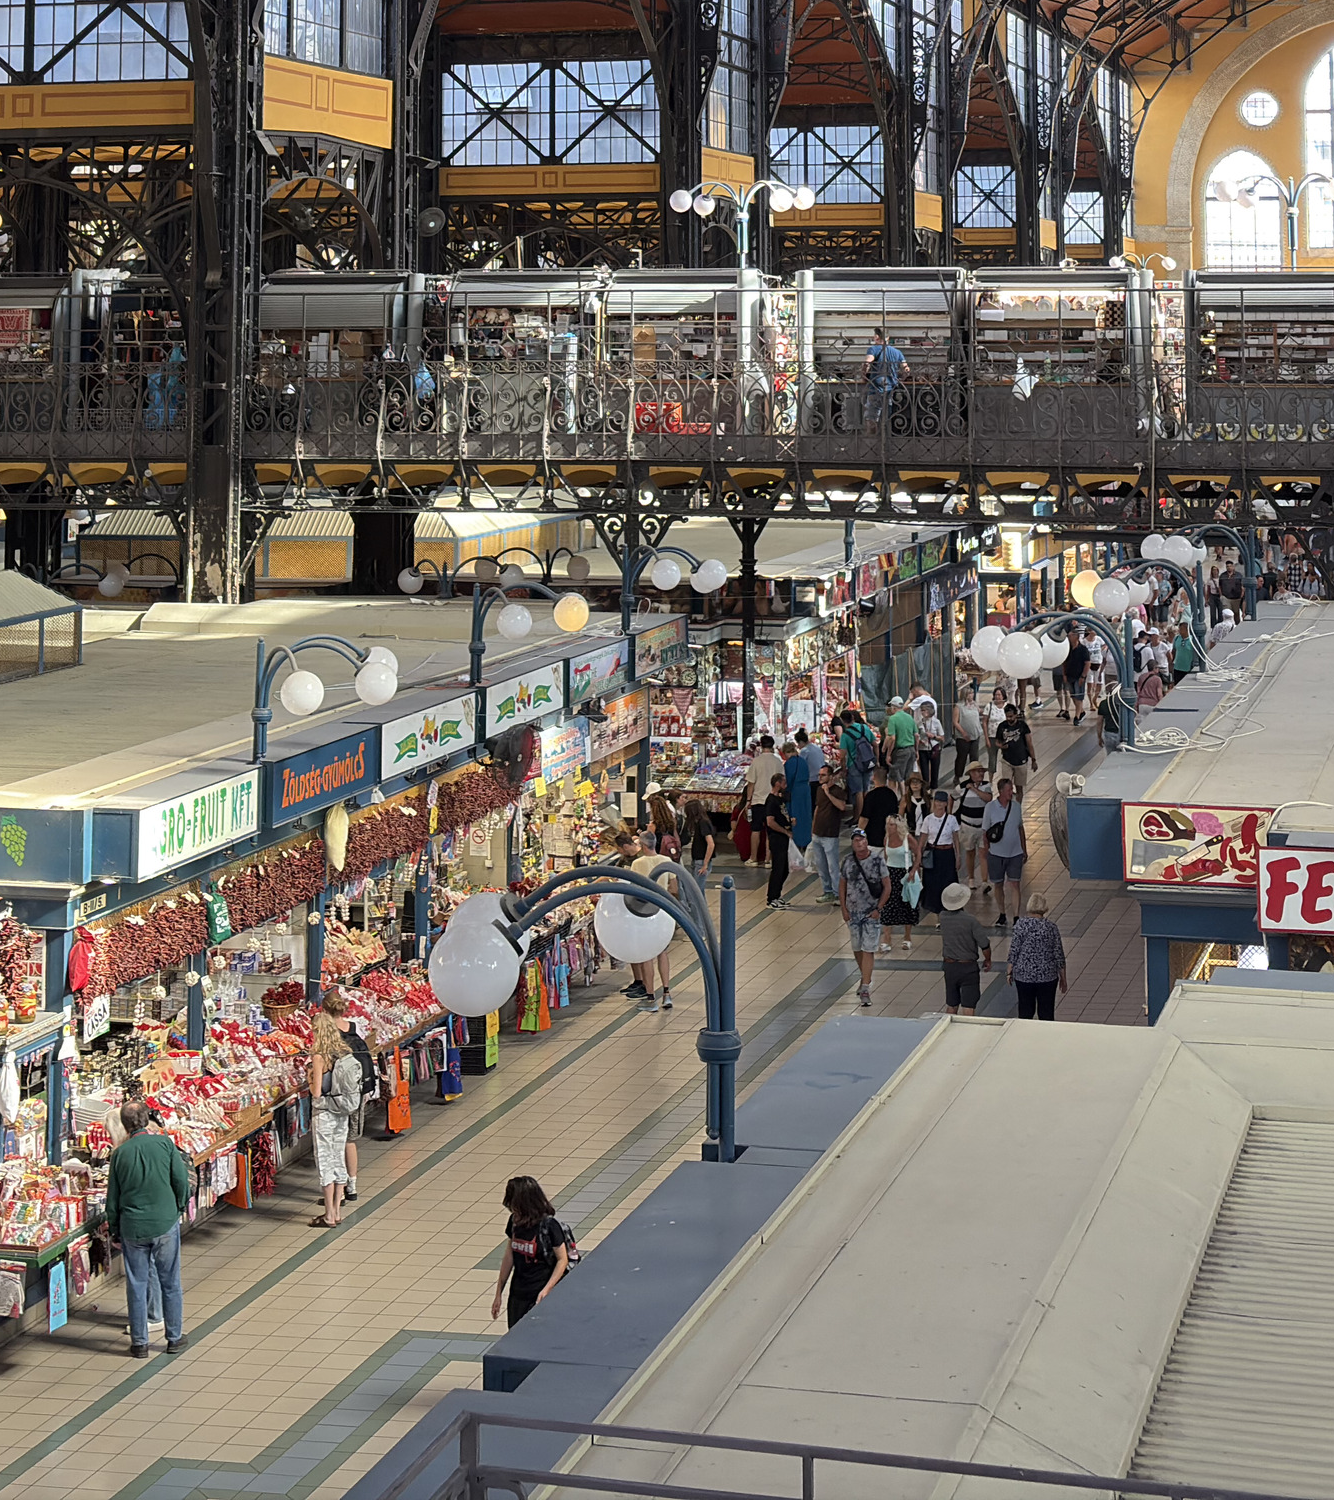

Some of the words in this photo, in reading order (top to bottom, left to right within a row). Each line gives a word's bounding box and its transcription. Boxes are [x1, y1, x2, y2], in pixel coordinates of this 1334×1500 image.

[154, 787, 227, 861] GRO-FRUIT
[230, 780, 254, 832] KFT.
[86, 1003, 108, 1038] CASSA
